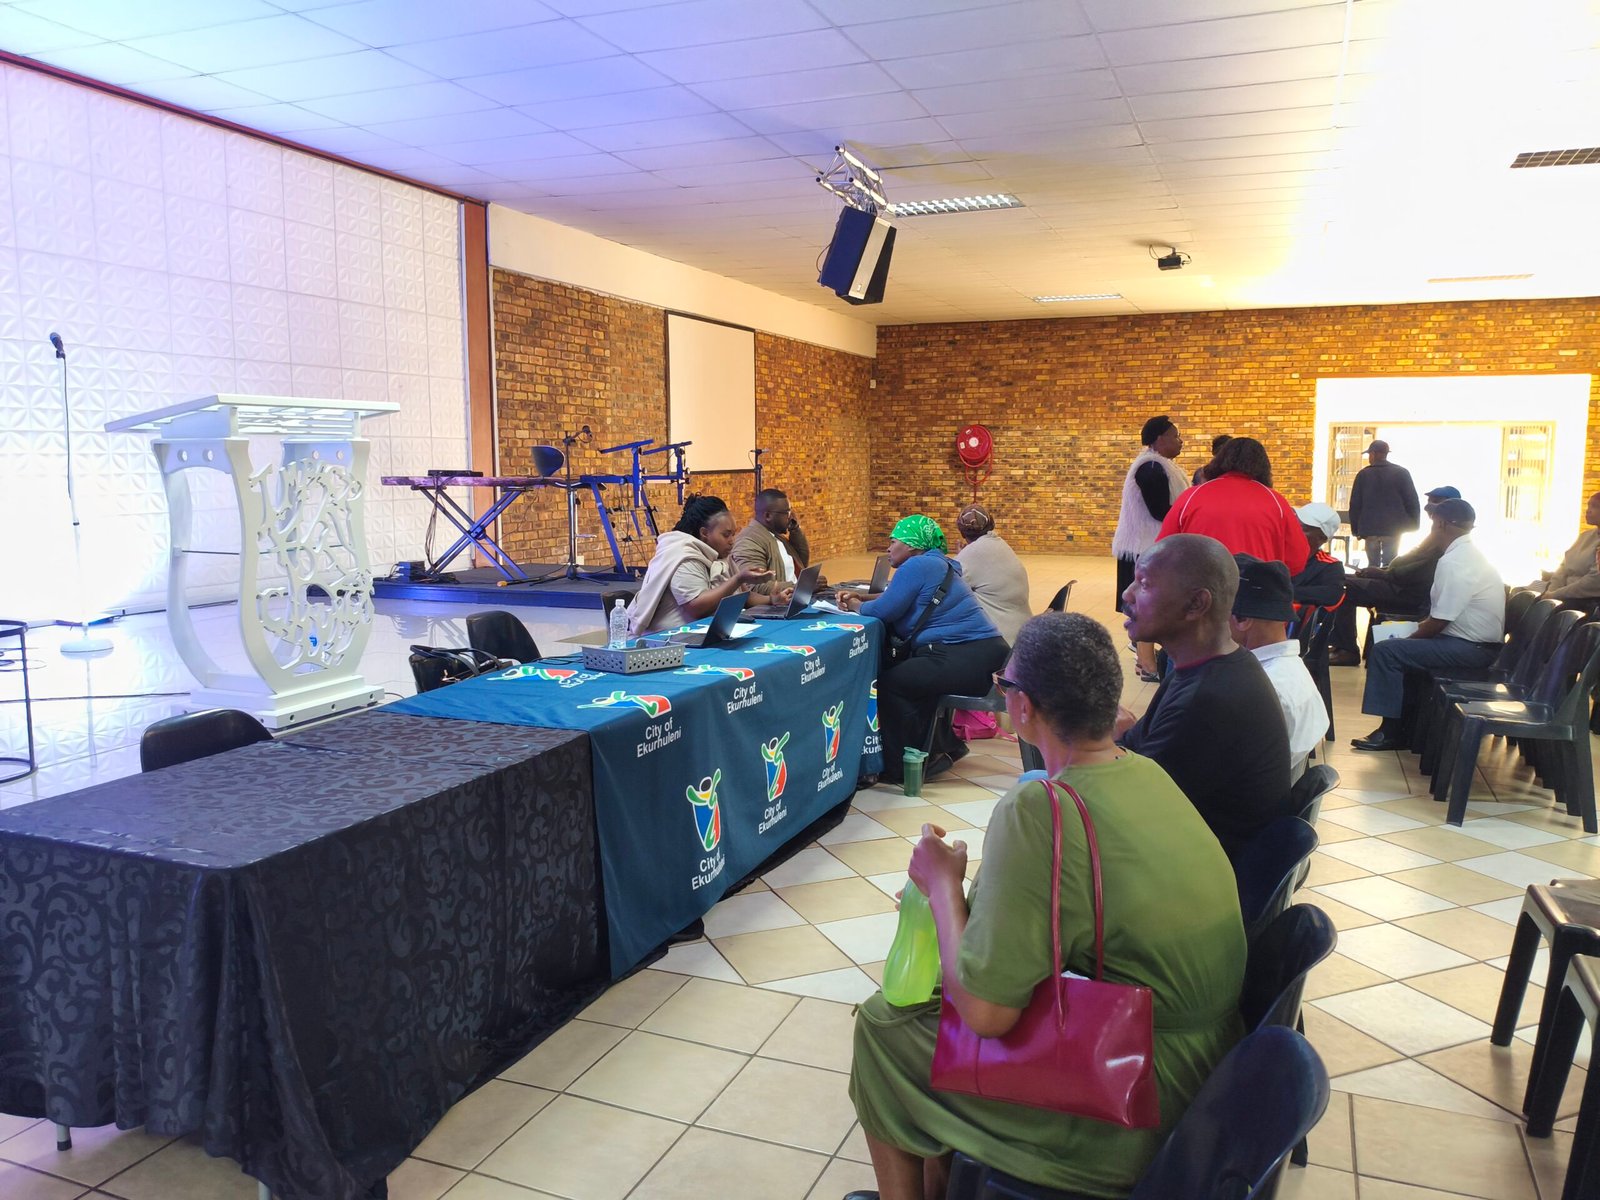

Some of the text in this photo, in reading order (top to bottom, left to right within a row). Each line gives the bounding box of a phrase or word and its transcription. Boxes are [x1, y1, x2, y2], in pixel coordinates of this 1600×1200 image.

[853, 637, 861, 648] City
[804, 656, 820, 672] City of
[734, 682, 756, 700] City of
[727, 691, 763, 714] Ekurhuleni
[646, 717, 673, 740] City of
[637, 726, 682, 758] Ekurhuleni
[822, 767, 831, 780] City
[765, 799, 782, 819] City of
[700, 857, 716, 872] City
